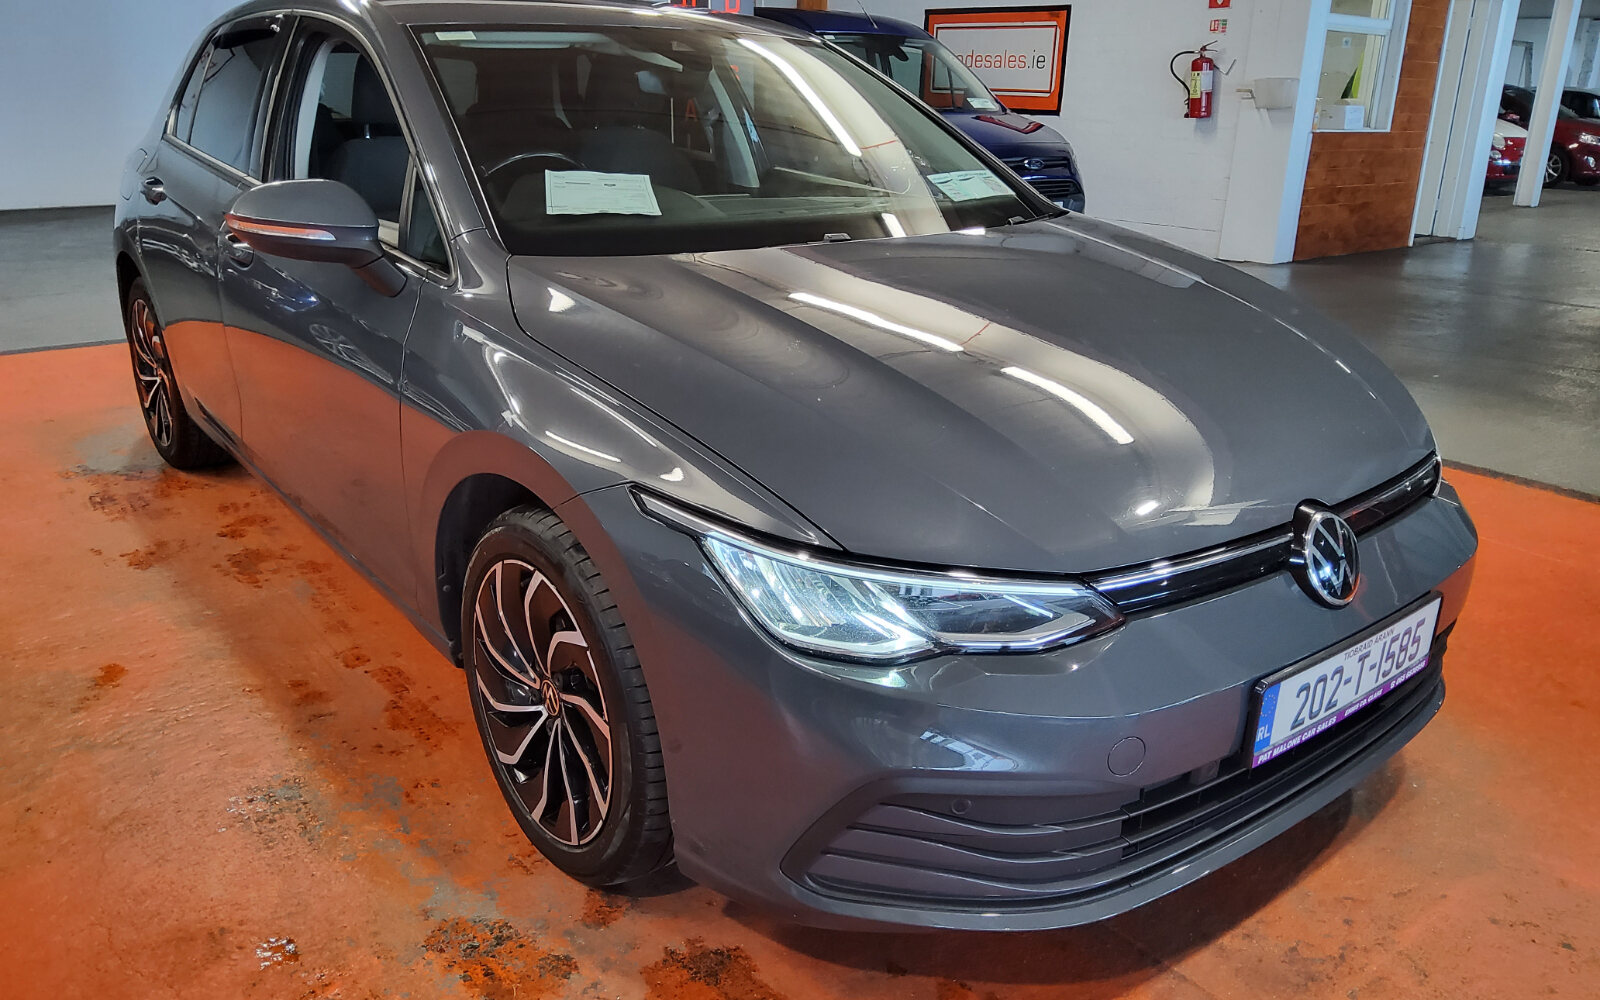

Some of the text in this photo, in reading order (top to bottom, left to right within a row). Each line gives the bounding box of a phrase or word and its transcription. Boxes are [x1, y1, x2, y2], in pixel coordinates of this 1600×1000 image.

[1290, 617, 1426, 731] 202-T-1585
[1257, 715, 1337, 765] PAT MALONE CAR SALES
